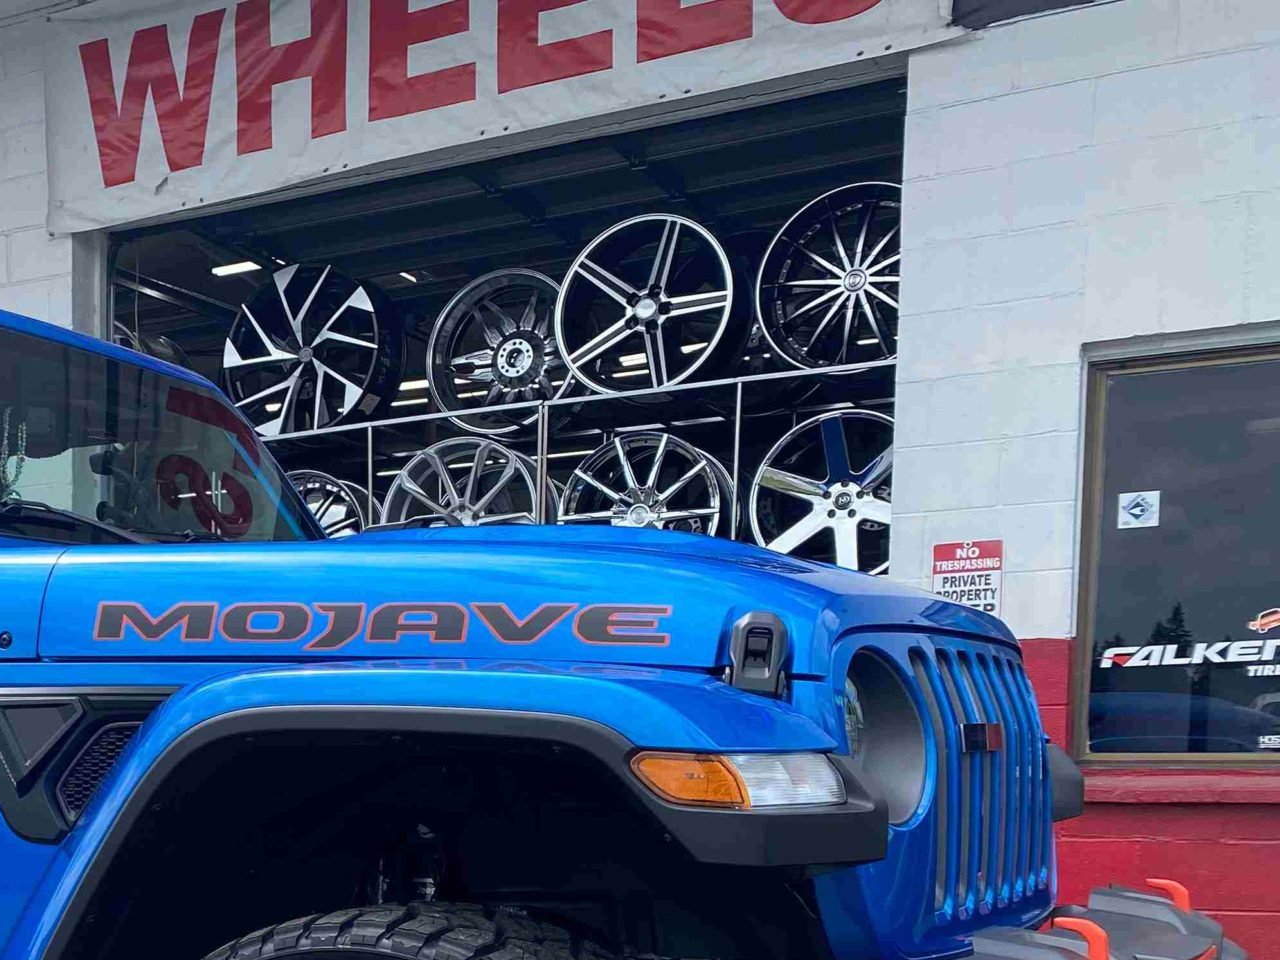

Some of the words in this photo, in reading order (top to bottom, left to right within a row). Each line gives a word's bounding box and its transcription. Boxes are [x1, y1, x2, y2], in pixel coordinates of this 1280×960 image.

[78, 0, 885, 189] WHEE
[956, 547, 980, 559] NO
[935, 557, 1000, 572] TRESPASSING
[942, 573, 992, 589] PRIVATE
[93, 601, 672, 650] MOJAVE
